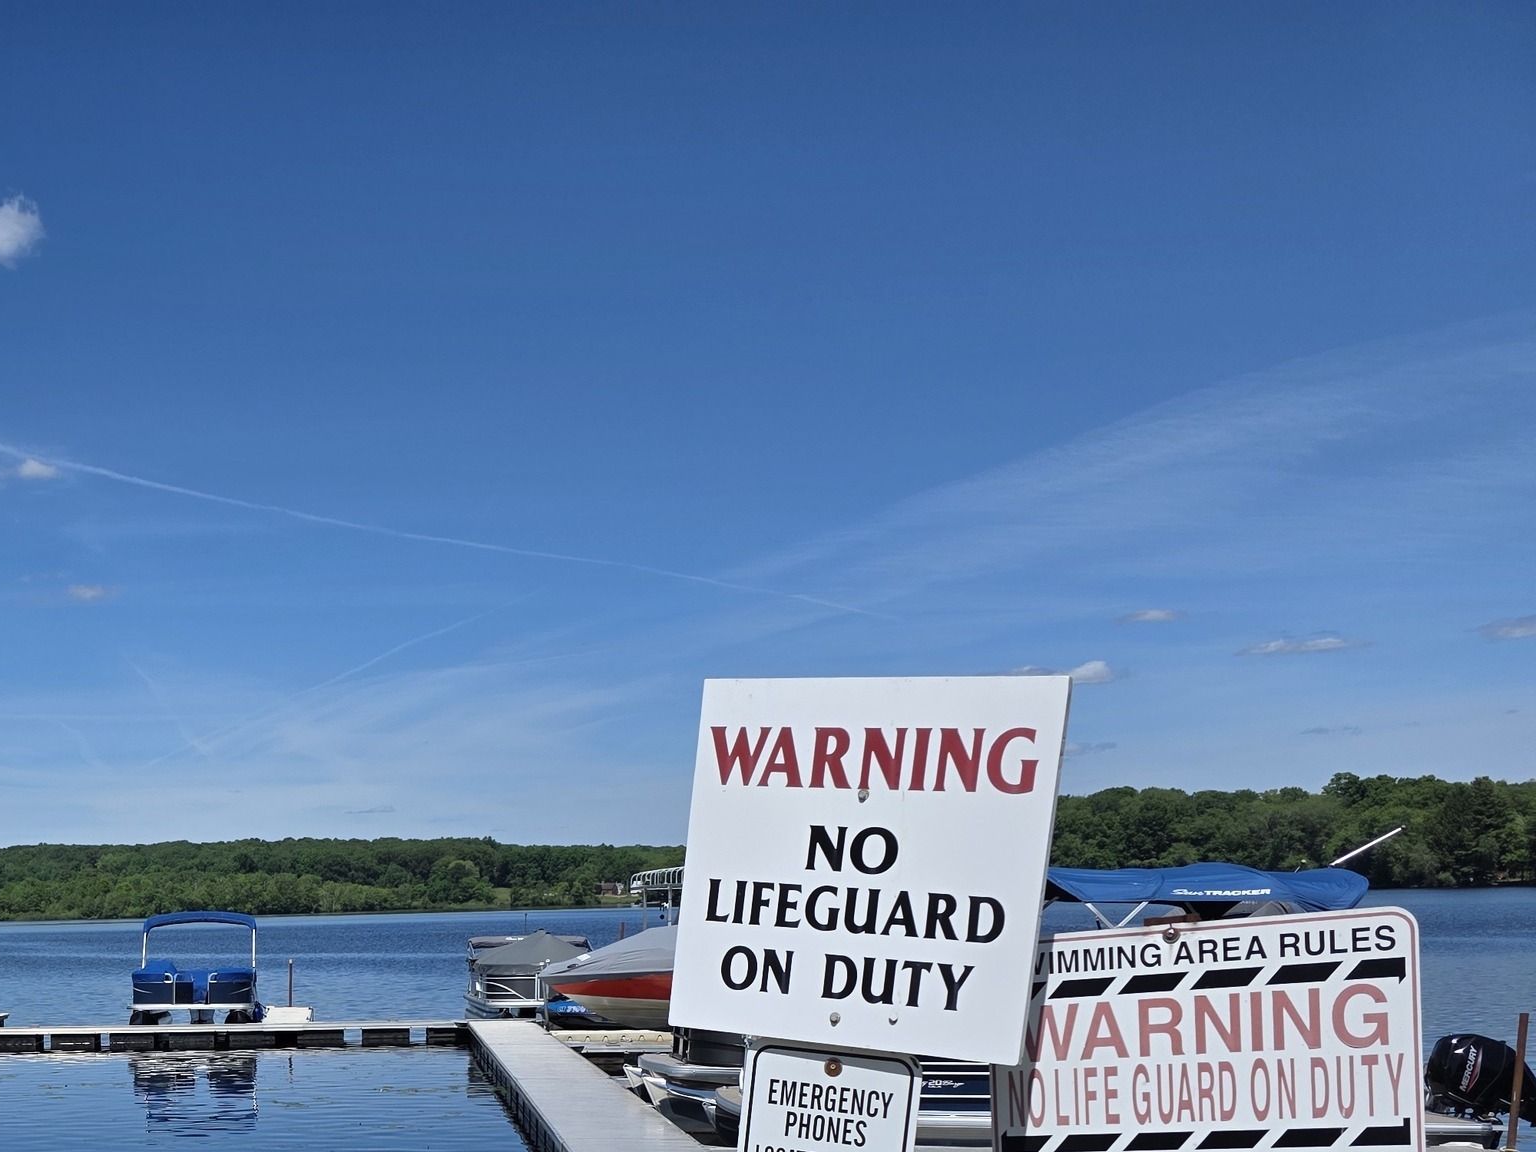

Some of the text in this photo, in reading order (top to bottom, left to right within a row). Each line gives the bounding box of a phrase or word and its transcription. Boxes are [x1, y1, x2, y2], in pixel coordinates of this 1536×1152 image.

[711, 726, 1039, 794] WARNING
[805, 825, 898, 875] NO
[705, 878, 1005, 944] LIFEGUARD
[720, 945, 974, 1011] ON DUTY
[1035, 925, 1396, 975] IMMING AREA RULES
[1025, 983, 1389, 1062] WARNING
[1008, 1053, 1404, 1128] NO LIFE GUARD ON DUTY
[1459, 1045, 1477, 1092] MERCURY
[768, 1079, 894, 1118] EMERGENCY
[784, 1111, 867, 1147] PHONES
